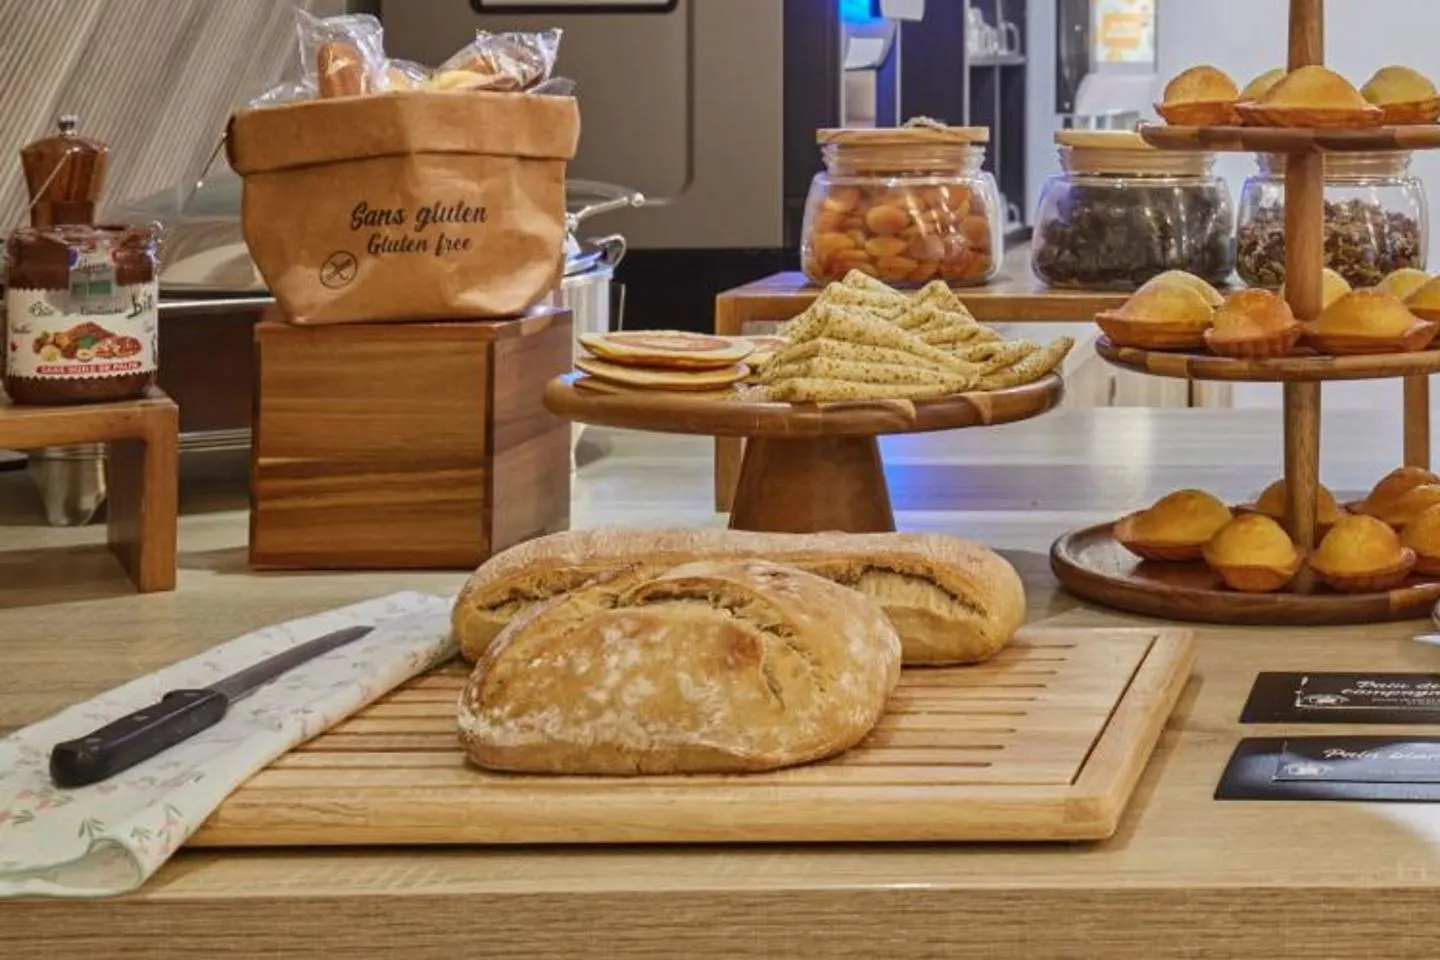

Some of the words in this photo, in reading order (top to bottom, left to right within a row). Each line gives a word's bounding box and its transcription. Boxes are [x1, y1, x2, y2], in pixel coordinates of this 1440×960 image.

[350, 201, 405, 231] Sans
[414, 200, 487, 233] gluten
[367, 233, 427, 255] Gluten
[434, 232, 472, 257] free
